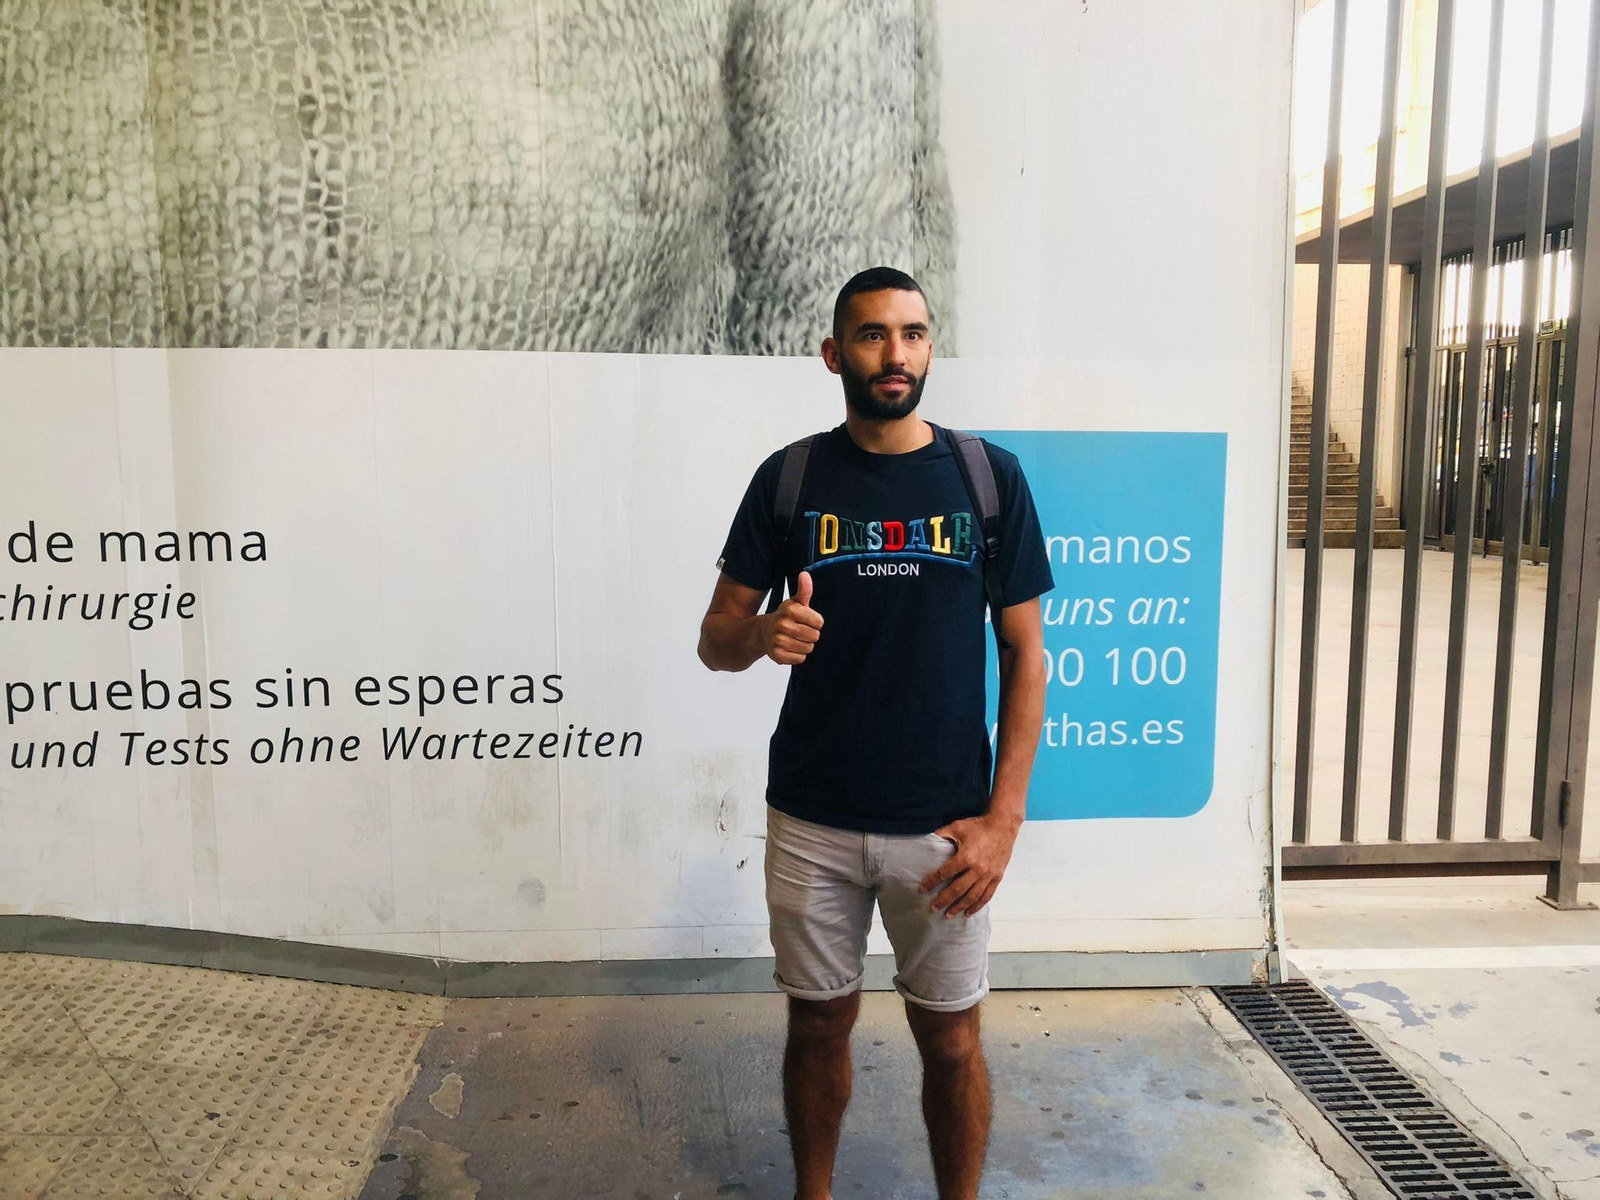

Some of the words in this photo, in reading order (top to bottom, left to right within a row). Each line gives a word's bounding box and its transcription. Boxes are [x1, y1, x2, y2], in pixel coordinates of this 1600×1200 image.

[8, 520, 74, 563] de
[99, 531, 267, 562] mama
[857, 563, 920, 577] LONDON
[1043, 597, 1116, 626] uns
[1128, 597, 1190, 625] an:
[1105, 646, 1187, 686] 100
[5, 668, 232, 725] pruebas
[255, 667, 330, 709] sin
[354, 674, 564, 717] esperas
[10, 730, 99, 769] und
[119, 732, 230, 766] Tests
[250, 727, 361, 764] ohne
[382, 723, 643, 761] Wartezeiten
